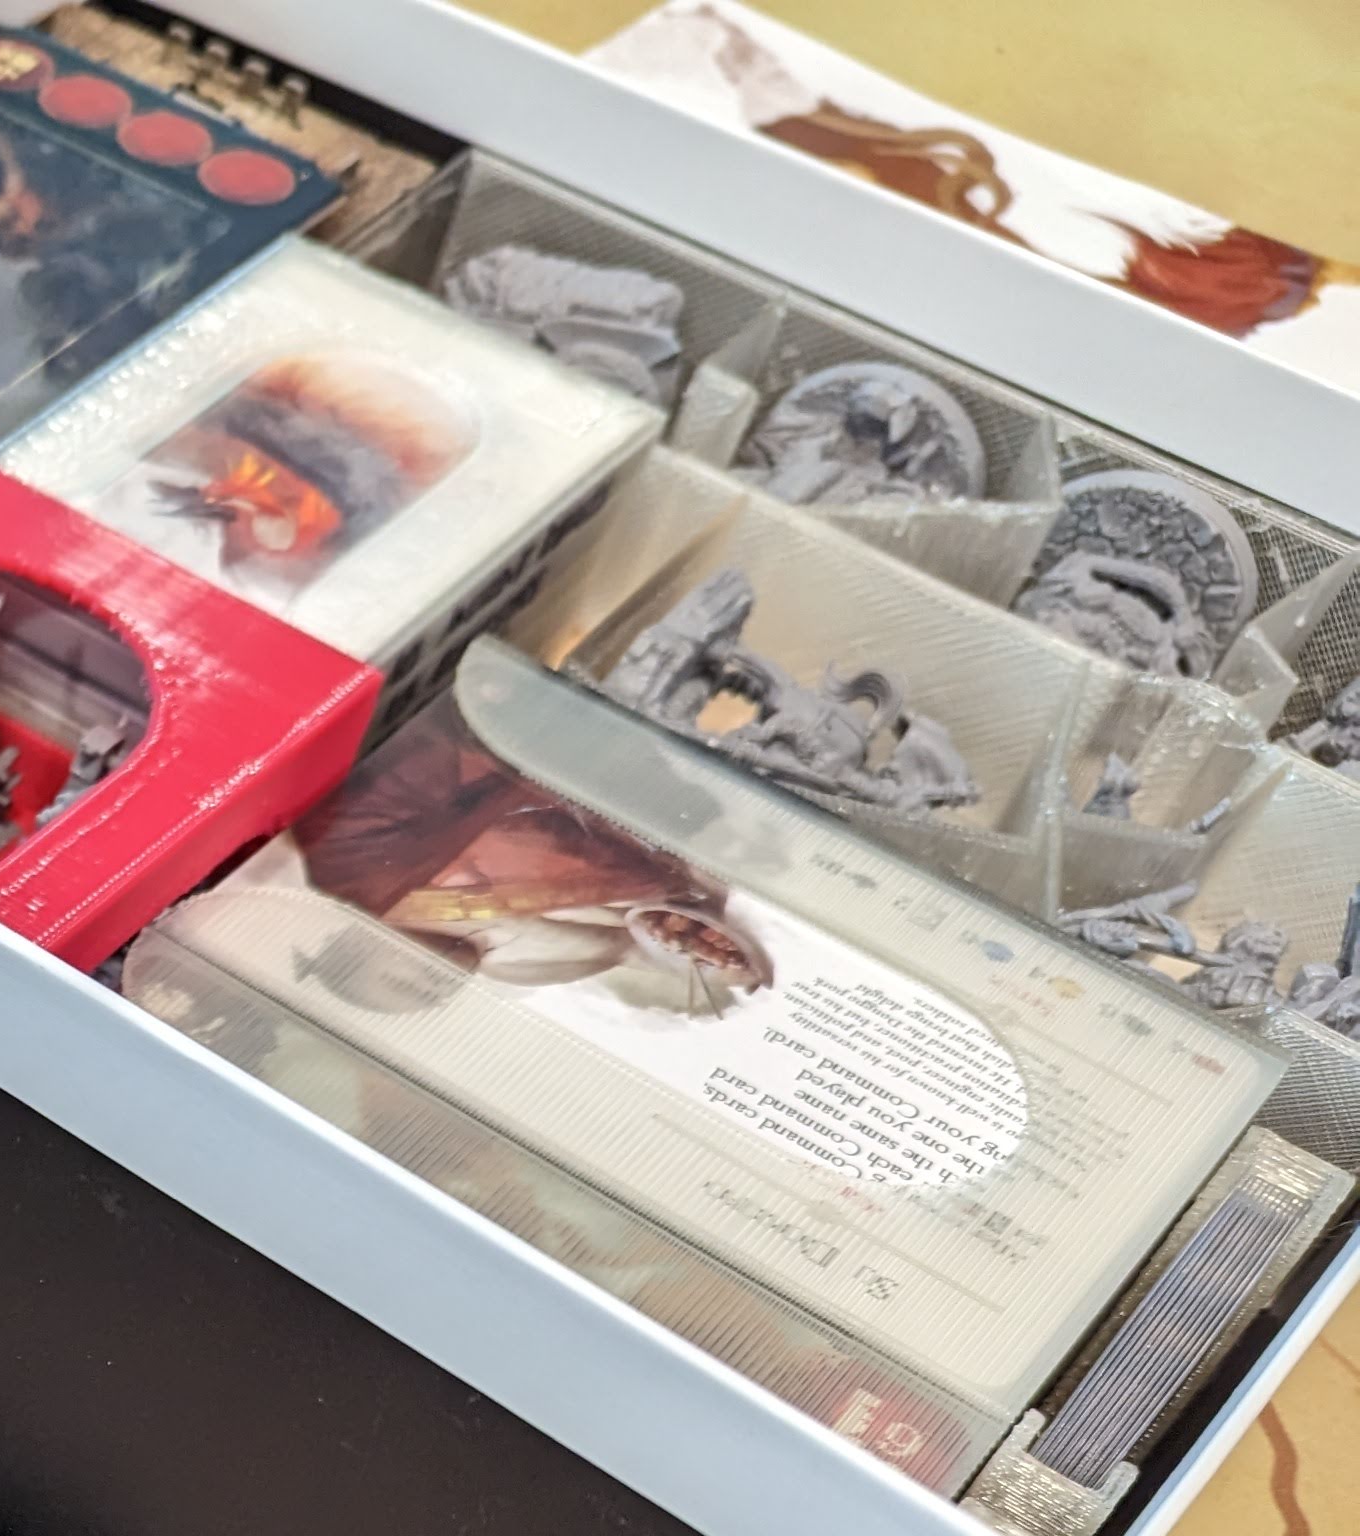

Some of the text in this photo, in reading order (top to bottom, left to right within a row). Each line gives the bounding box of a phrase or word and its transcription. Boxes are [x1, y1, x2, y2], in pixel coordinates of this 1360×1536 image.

[708, 1066, 914, 1182] each Command card
[793, 1089, 933, 1170] the same name
[794, 1068, 984, 1174] the one you played
[815, 1057, 920, 1123] Command
[923, 1115, 980, 1146] your
